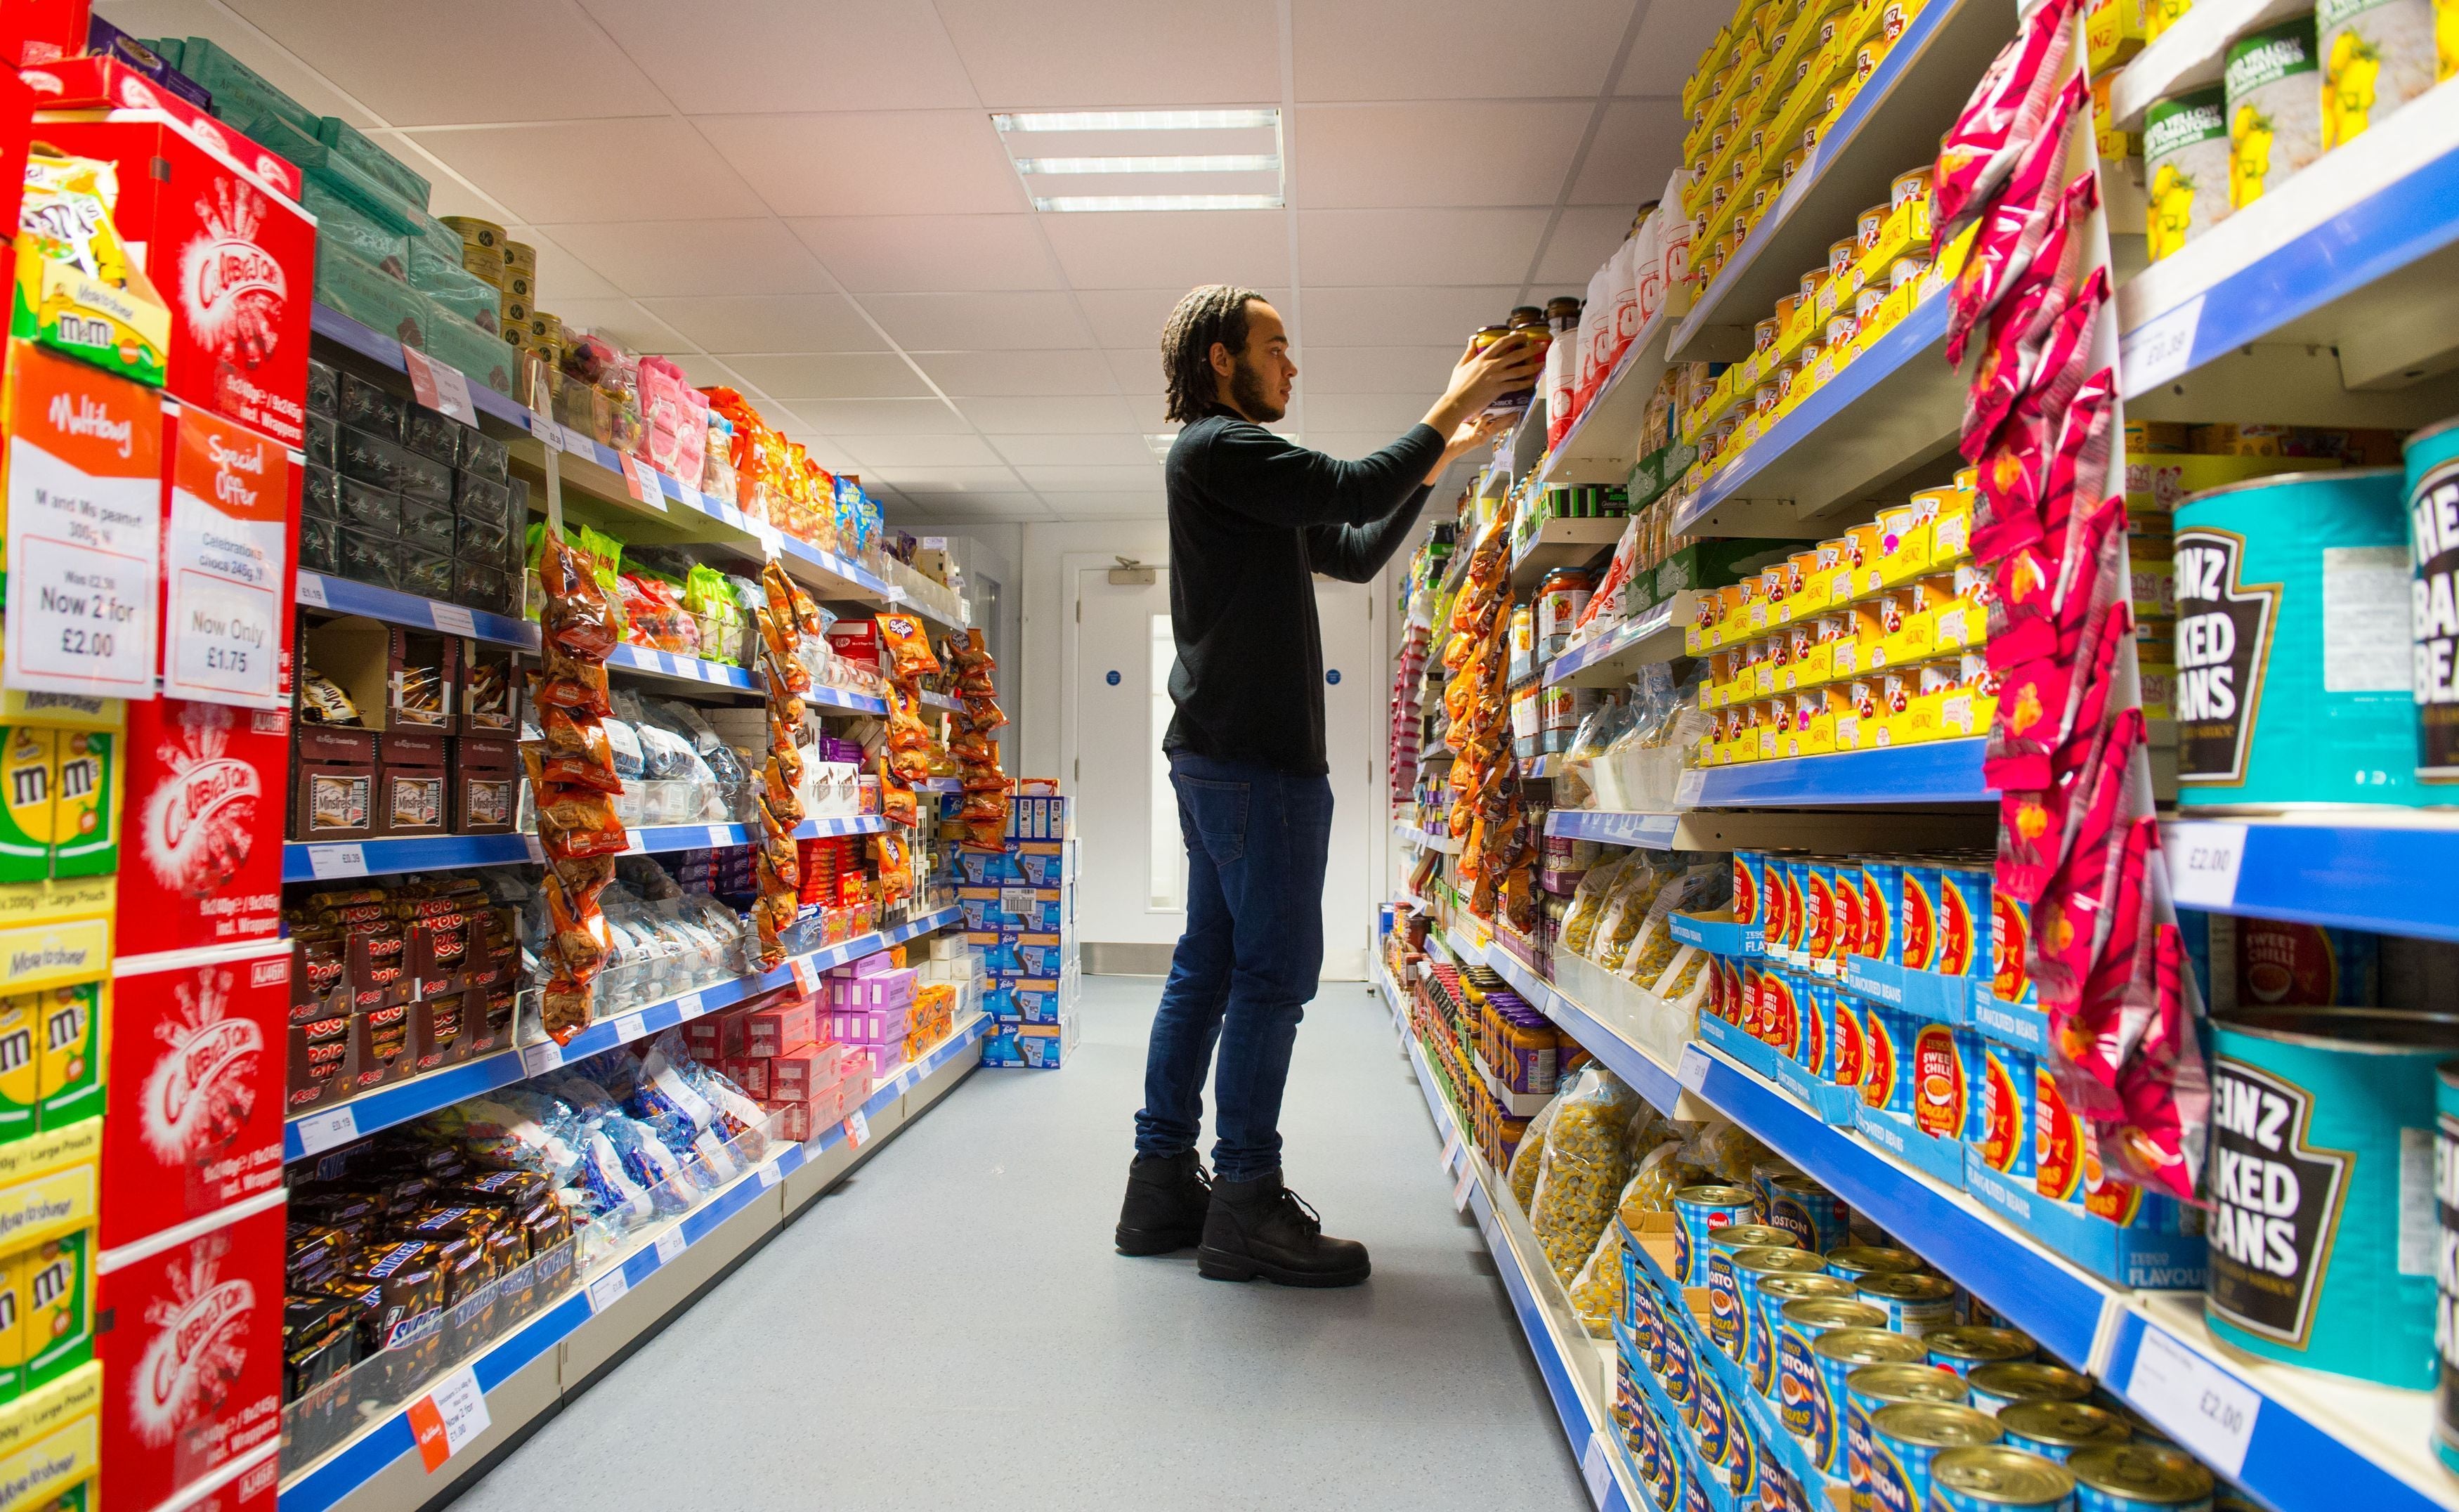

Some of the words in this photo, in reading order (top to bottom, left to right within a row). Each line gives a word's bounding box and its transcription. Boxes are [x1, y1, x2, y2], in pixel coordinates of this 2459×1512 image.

[1884, 225, 1902, 250] HEINZ
[1794, 316, 1810, 334] HEINZ
[1881, 307, 1901, 329] HEINZ
[1794, 382, 1808, 403] HEINZ
[49, 393, 131, 458] Multibuy
[261, 409, 301, 441] Wrappers
[209, 434, 263, 475] Special
[216, 471, 258, 507] Offer
[100, 505, 141, 528] peanut
[202, 533, 263, 560] Celebrations
[1900, 547, 1922, 567] HEINZ
[2174, 546, 2226, 602] INZ
[41, 587, 84, 615] Now
[92, 595, 103, 618] 2
[109, 597, 133, 622] for
[1807, 587, 1822, 602] HEINZ
[192, 611, 228, 635] Now
[230, 620, 263, 649] Only
[1734, 618, 1747, 629] HEINZ
[61, 629, 113, 657] £2.00
[1906, 630, 1924, 645] HEINZ
[2177, 612, 2236, 666] KED
[207, 647, 247, 673] £1.75
[1811, 658, 1825, 671] HEINZ
[2177, 665, 2236, 722] ANS
[1911, 713, 1931, 730] HEINZ
[1813, 729, 1827, 741] HEINZ
[318, 796, 351, 809] Minstrels
[398, 797, 425, 809] Minstrels
[474, 797, 497, 809] Minstrels
[343, 854, 360, 863] £0.39
[2190, 847, 2230, 872] £2.00
[422, 979, 447, 994] Rolo
[1849, 975, 1881, 997] FLAVOURED
[1882, 986, 1902, 1003] BEANS
[357, 990, 381, 1005] Rolo
[2016, 1021, 2039, 1042] BEANS
[1923, 1052, 1951, 1065] SWEE
[1924, 1062, 1951, 1075] CHILL
[358, 1069, 384, 1086] Rolo
[289, 1086, 320, 1104] Rolo
[332, 1117, 351, 1131] £0.19
[2218, 1147, 2301, 1220] KED
[1709, 1218, 1727, 1227] New!
[367, 1241, 426, 1277] SNICKERS
[1709, 1272, 1733, 1288] OSTO
[2130, 1267, 2205, 1286] FLAVOU
[446, 1416, 459, 1428] Now
[460, 1409, 464, 1417] 2
[2199, 1386, 2244, 1436] £2.00
